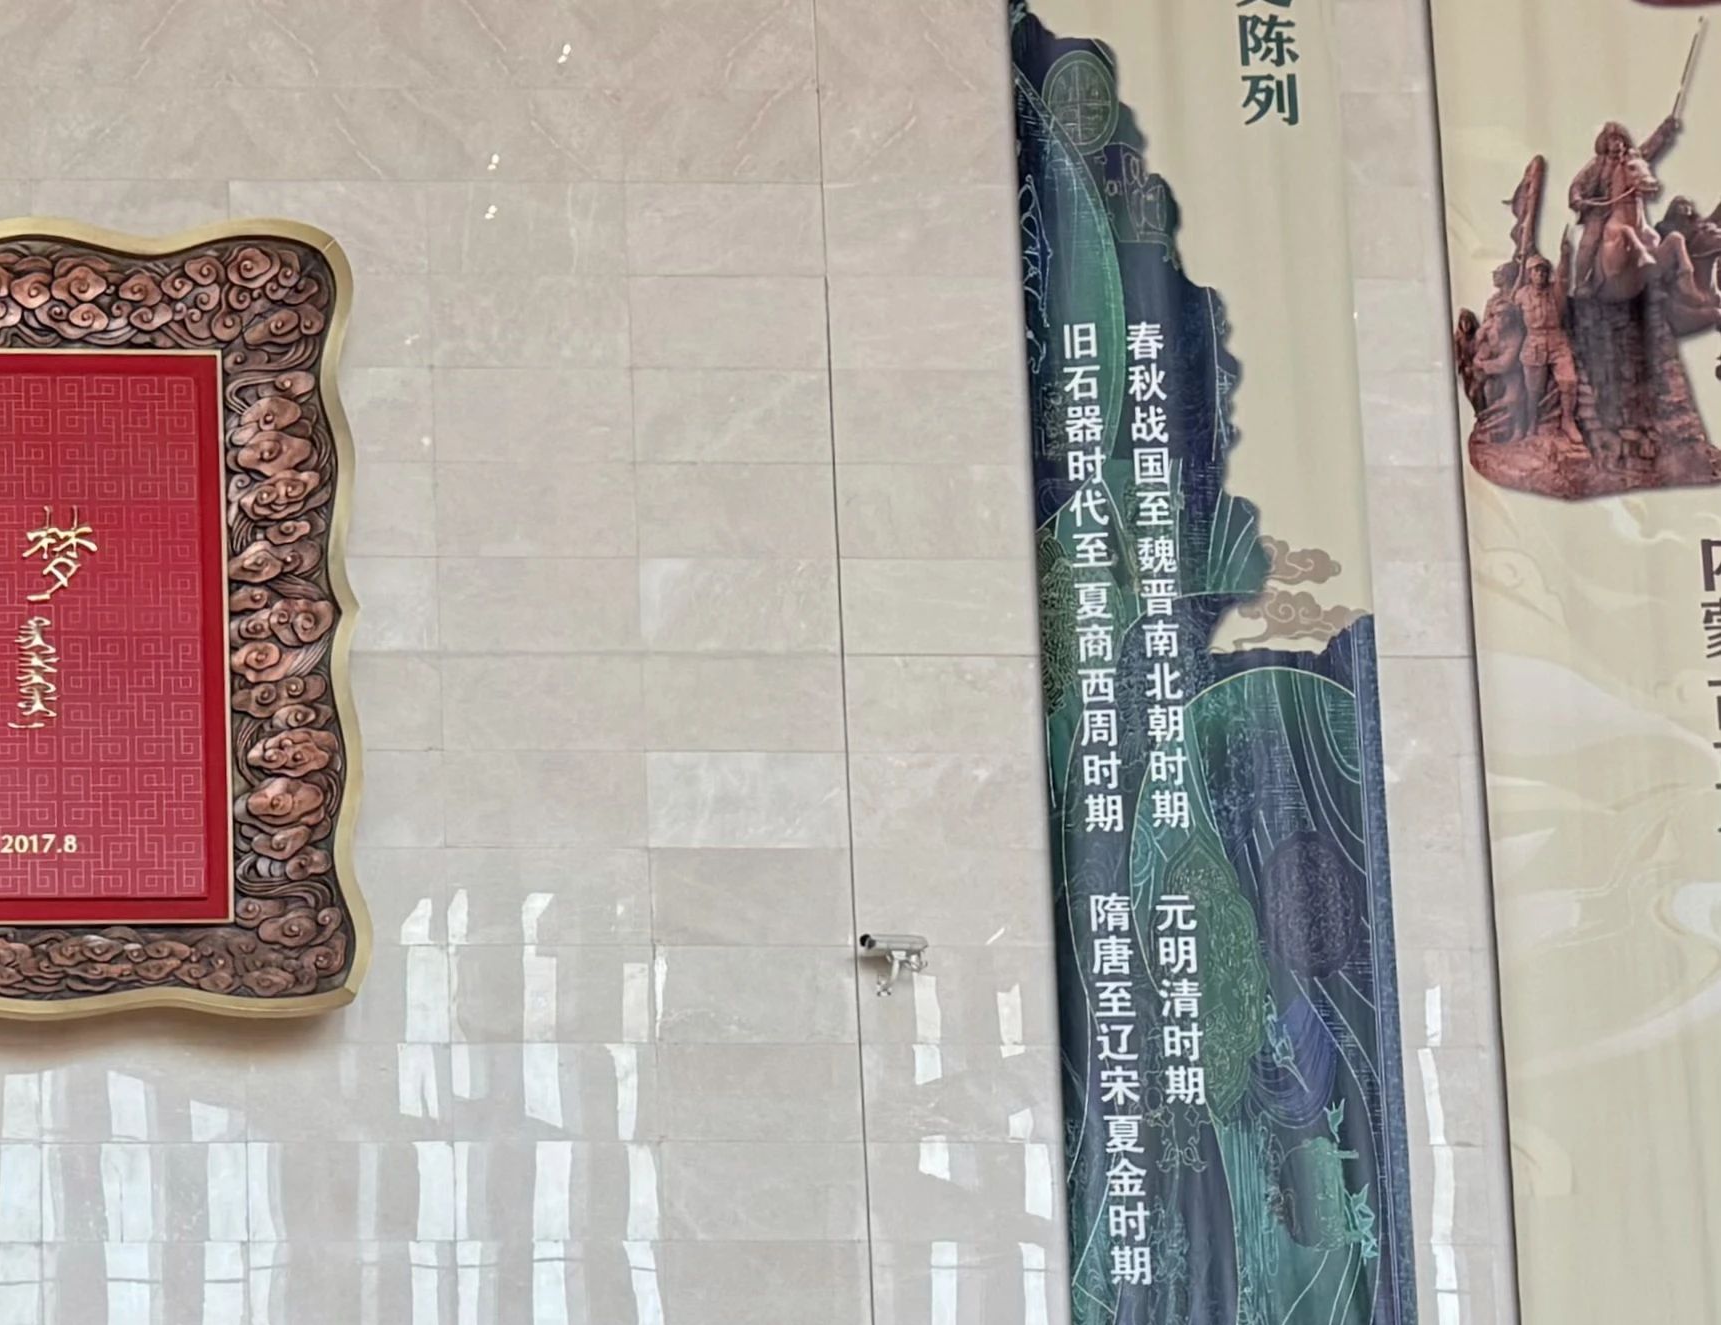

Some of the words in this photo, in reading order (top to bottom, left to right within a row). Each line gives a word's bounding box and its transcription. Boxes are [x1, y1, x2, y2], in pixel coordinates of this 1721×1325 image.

[1236, 0, 1300, 126] 陈列
[1063, 324, 1124, 832] 旧石器时代至夏商西周时期
[1126, 322, 1190, 829] 春秋战国至魏晋南北朝时期
[0, 833, 78, 855] 2017.8
[1088, 893, 1153, 1286] 隋唐至辽宋夏金时期
[1155, 895, 1207, 1105] 元明清时期
